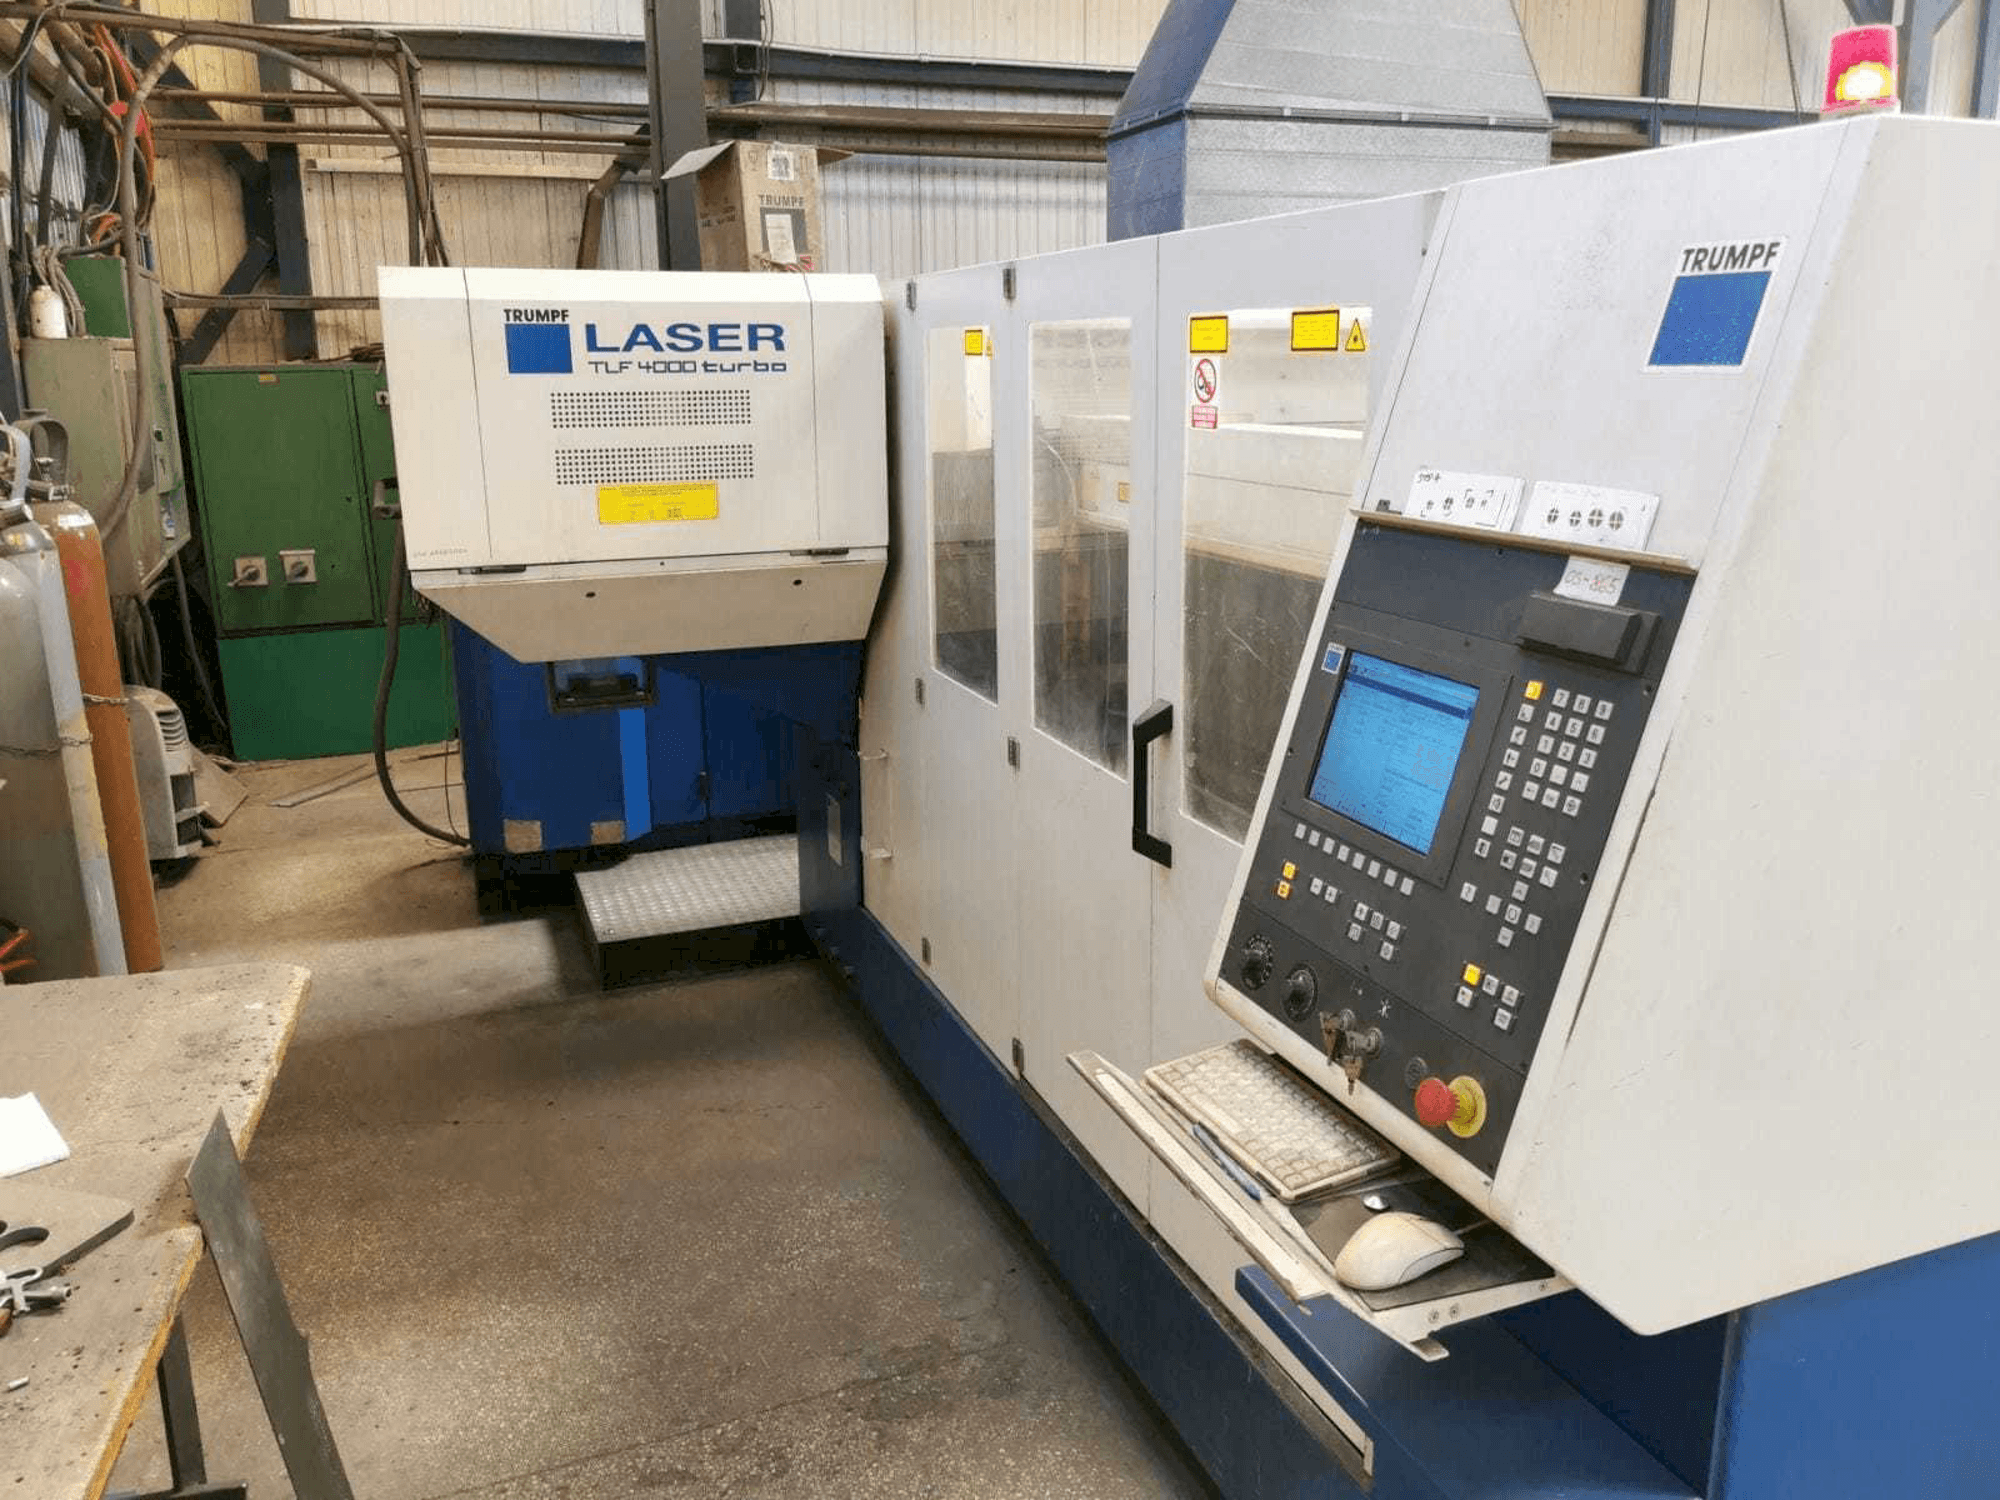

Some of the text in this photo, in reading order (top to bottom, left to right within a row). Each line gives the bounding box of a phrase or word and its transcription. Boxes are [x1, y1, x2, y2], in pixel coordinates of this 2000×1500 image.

[758, 193, 804, 208] TRUMPF
[1680, 242, 1781, 273] TRUMPF
[503, 308, 570, 322] TRUMPF
[585, 323, 786, 352] LASER
[588, 359, 787, 374] TLF 4000 turbo
